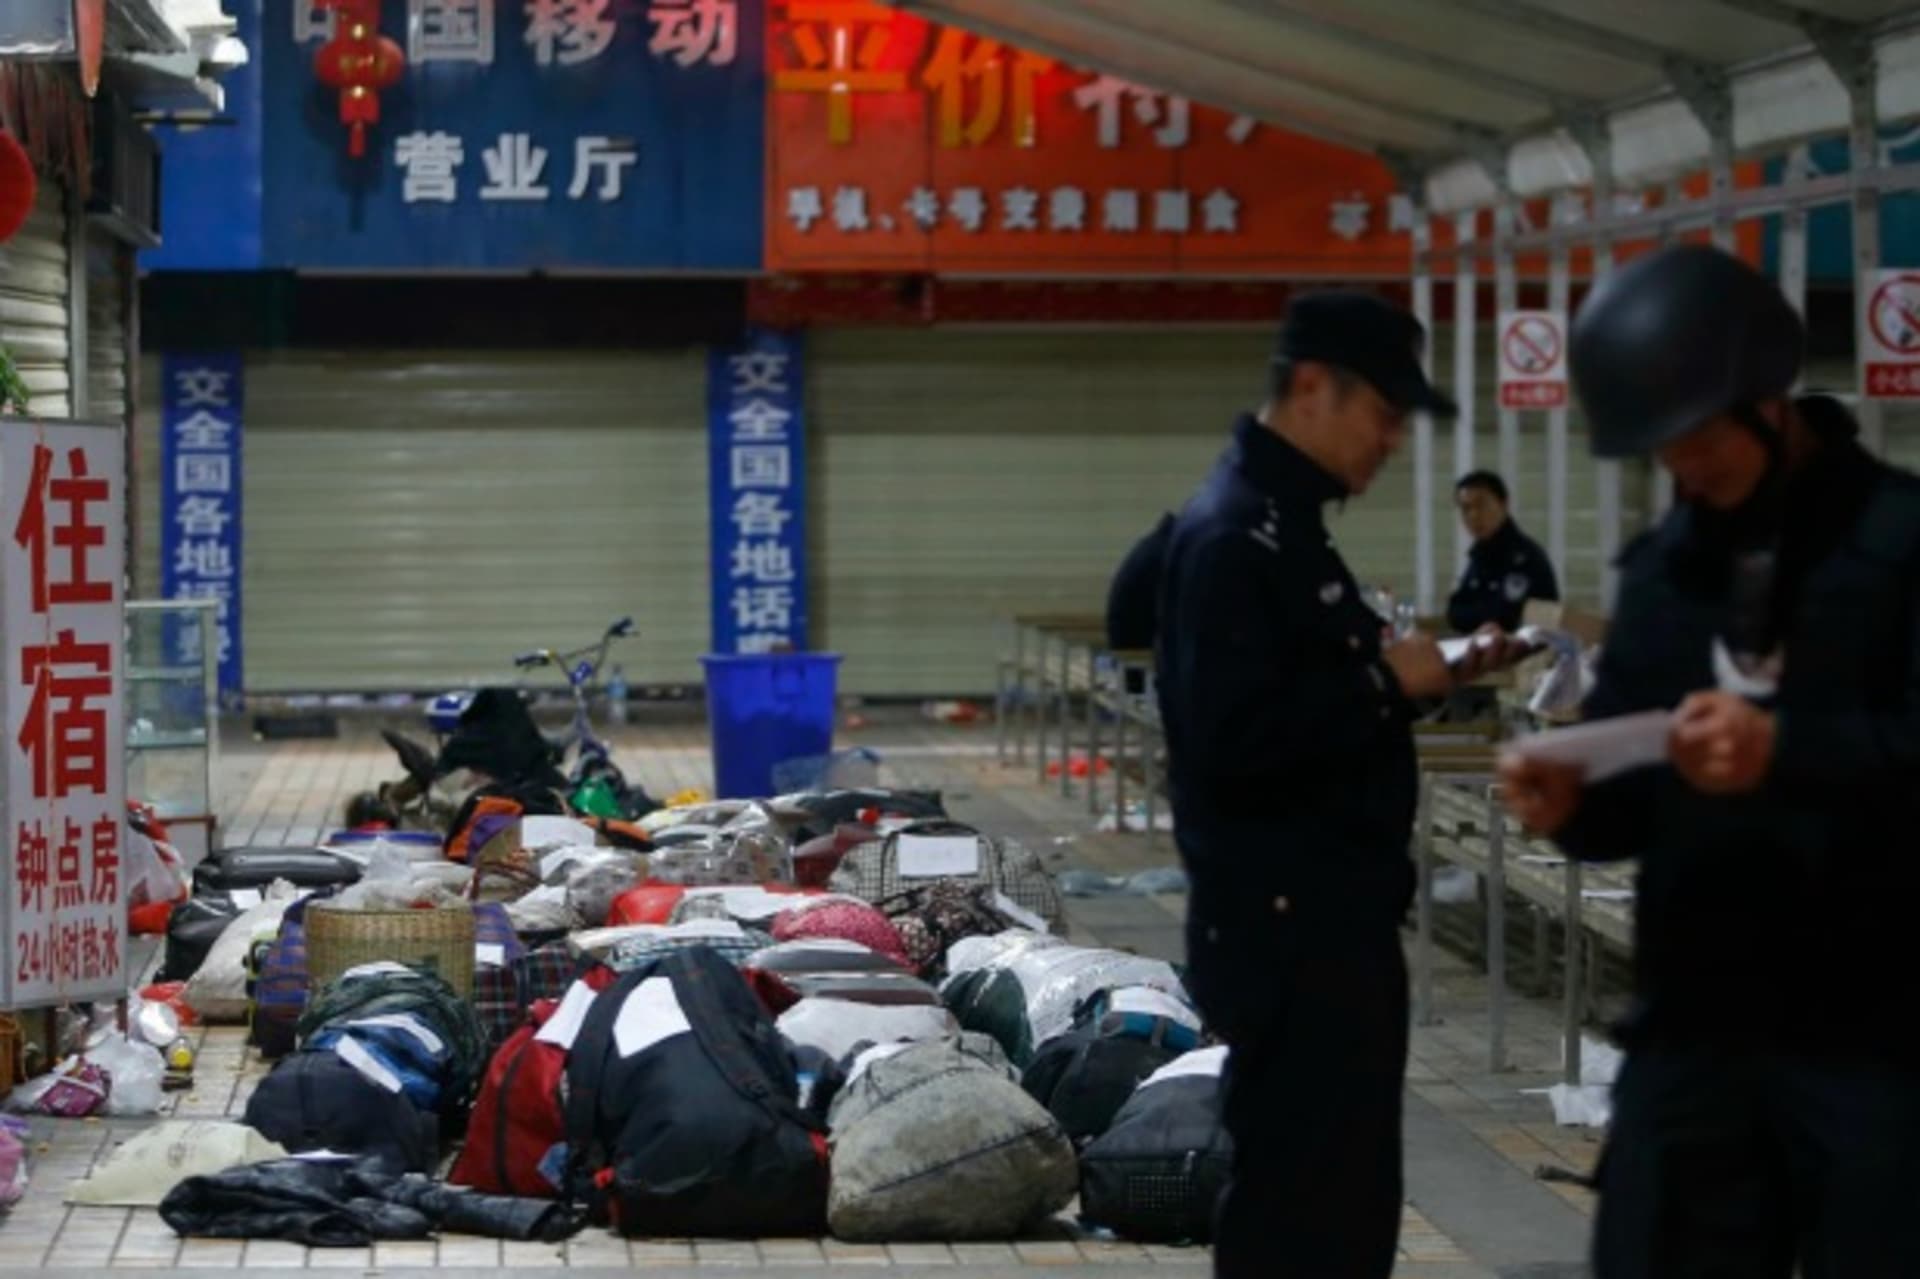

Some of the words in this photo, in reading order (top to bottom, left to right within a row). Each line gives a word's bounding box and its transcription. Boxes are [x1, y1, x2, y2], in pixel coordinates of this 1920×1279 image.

[395, 132, 638, 203] 营业厅
[13, 444, 113, 799] 住宿
[17, 812, 119, 913] 钟点房
[17, 914, 119, 983] 24小时热水
